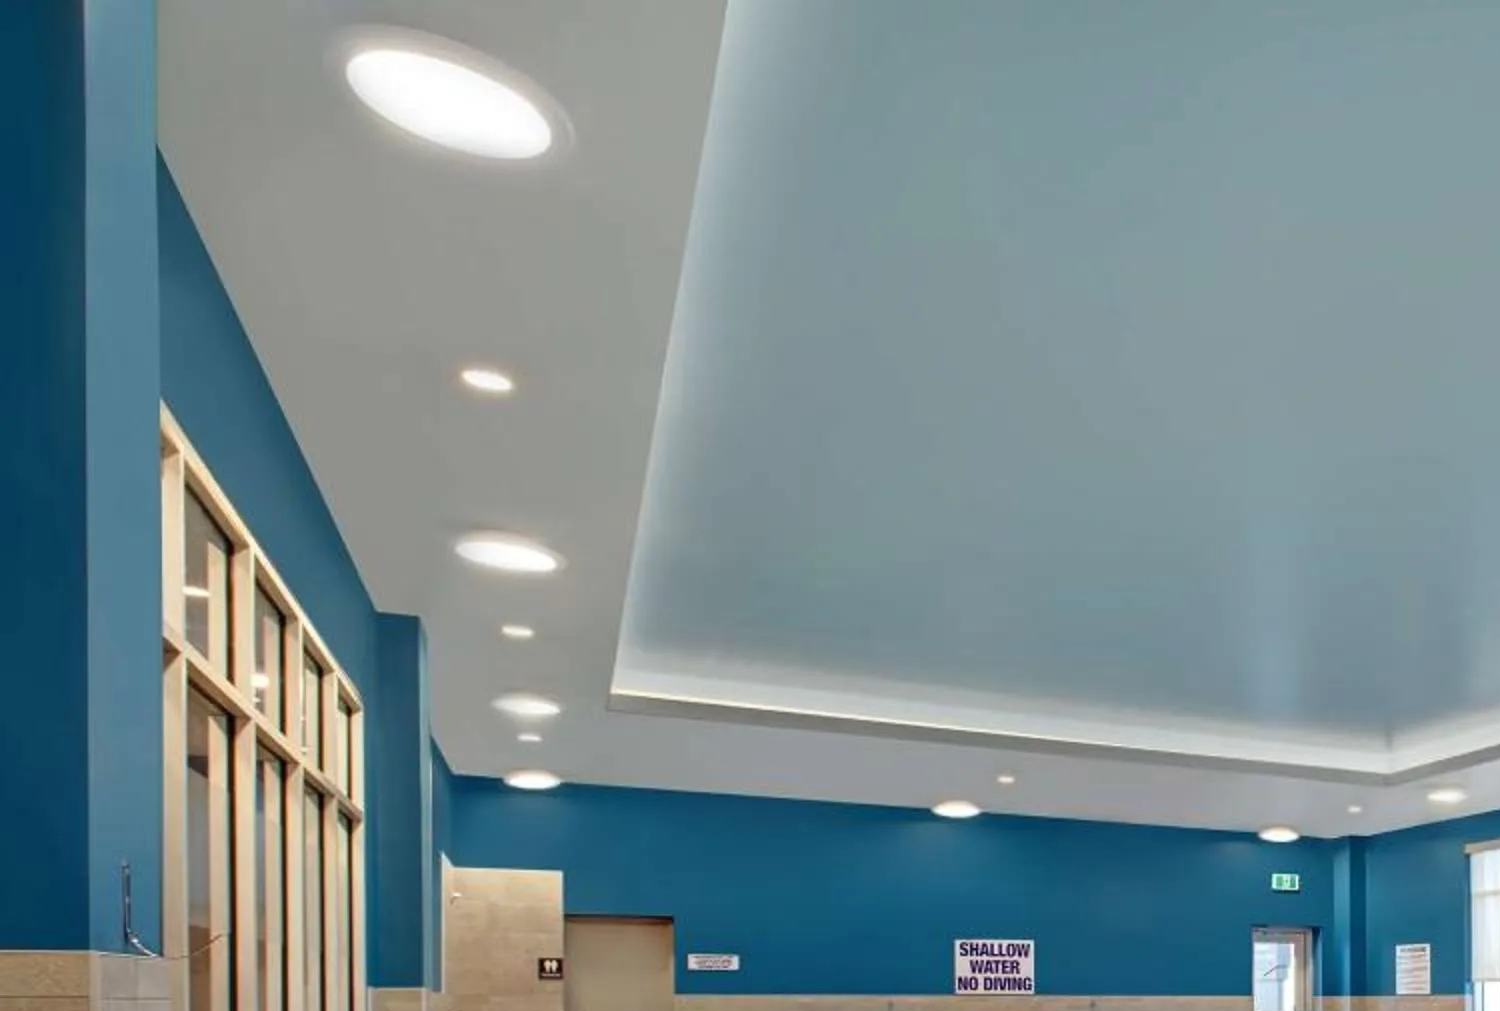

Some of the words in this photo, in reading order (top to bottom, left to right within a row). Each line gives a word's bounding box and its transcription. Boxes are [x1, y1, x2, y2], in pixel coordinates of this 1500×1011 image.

[959, 942, 1030, 957] SHALLOW
[969, 960, 1020, 974] WATER
[957, 976, 979, 991] NO
[983, 976, 1032, 991] DIVING
